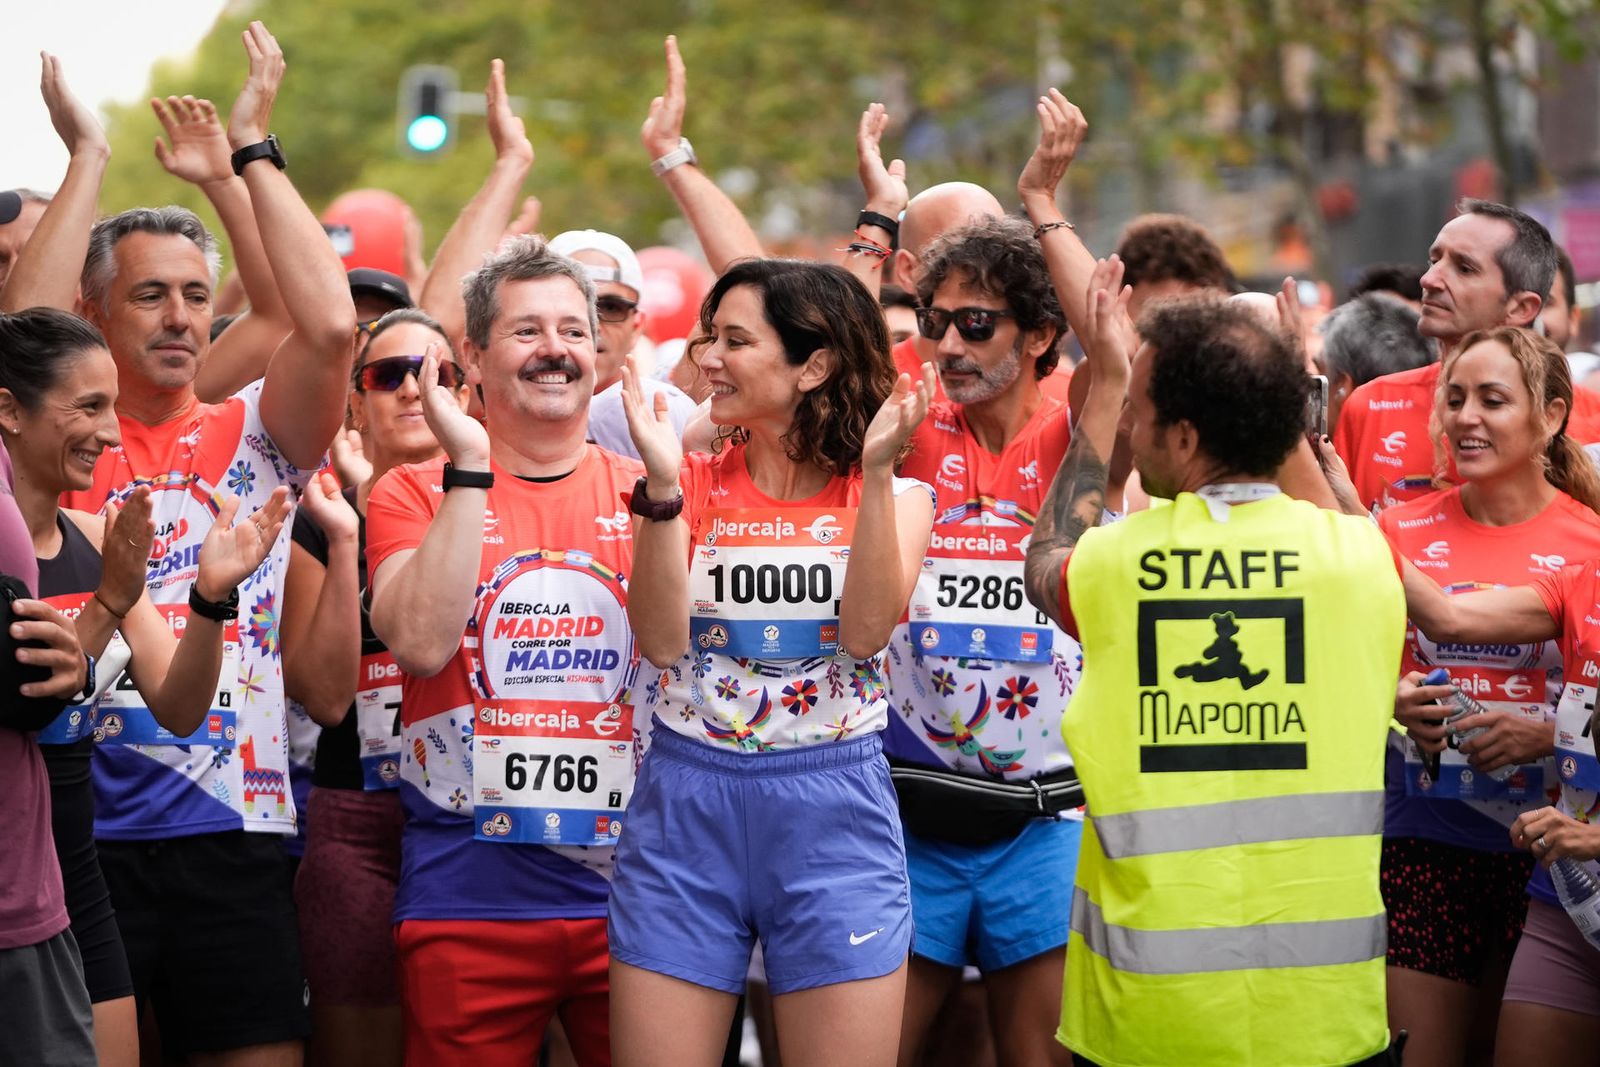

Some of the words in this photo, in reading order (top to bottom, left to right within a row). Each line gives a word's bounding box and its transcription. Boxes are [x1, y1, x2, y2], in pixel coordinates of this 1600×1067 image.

[713, 516, 796, 541] Ibercaja
[927, 533, 1008, 555] bercaja
[1137, 548, 1300, 591] STAFF
[707, 563, 832, 605] 10000
[936, 573, 1024, 611] 5286
[499, 602, 571, 615] IBERCAJA
[493, 615, 605, 639] MADRID
[512, 639, 546, 649] CORRE
[548, 639, 571, 648] POR
[505, 649, 620, 672] MADRID
[535, 675, 565, 684] ESPECIAL
[490, 708, 581, 732] Ibercaja
[1139, 690, 1307, 743] MAPOMA
[504, 752, 599, 794] 6766
